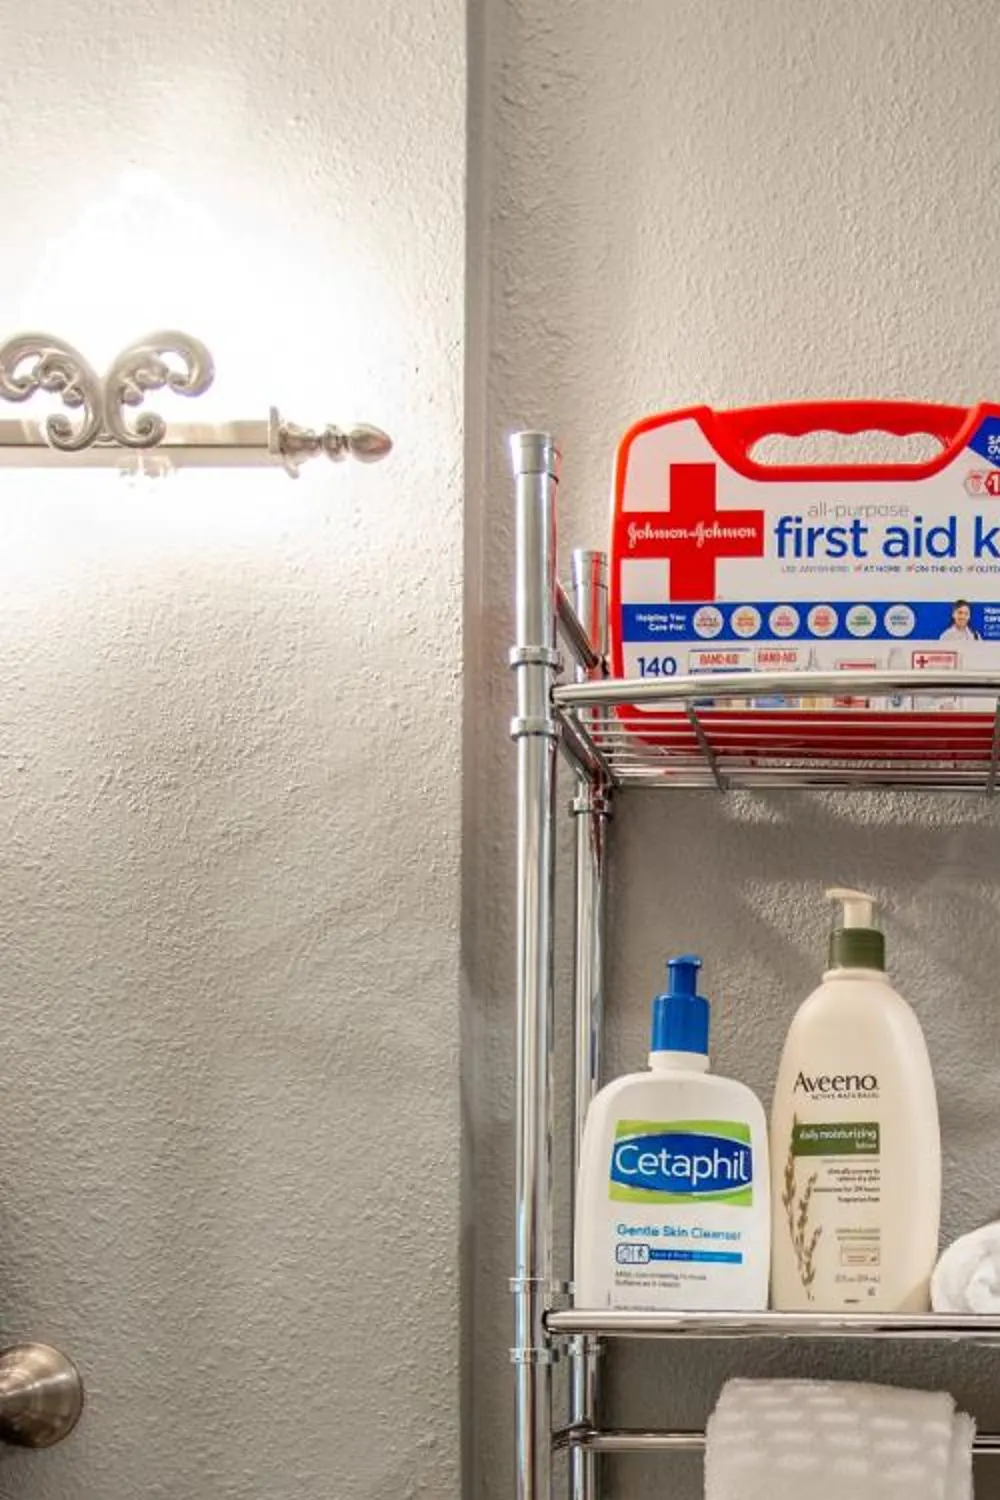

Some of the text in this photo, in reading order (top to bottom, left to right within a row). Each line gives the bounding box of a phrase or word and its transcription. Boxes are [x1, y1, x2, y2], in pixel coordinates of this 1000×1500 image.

[807, 502, 911, 520] all-purpose
[774, 515, 868, 559] first
[882, 515, 957, 558] aid
[636, 656, 678, 678] 140
[794, 1072, 877, 1092] Aveeno
[615, 1145, 750, 1187] Cetaphil
[617, 1223, 742, 1241] Gentle Skin Cleanser
